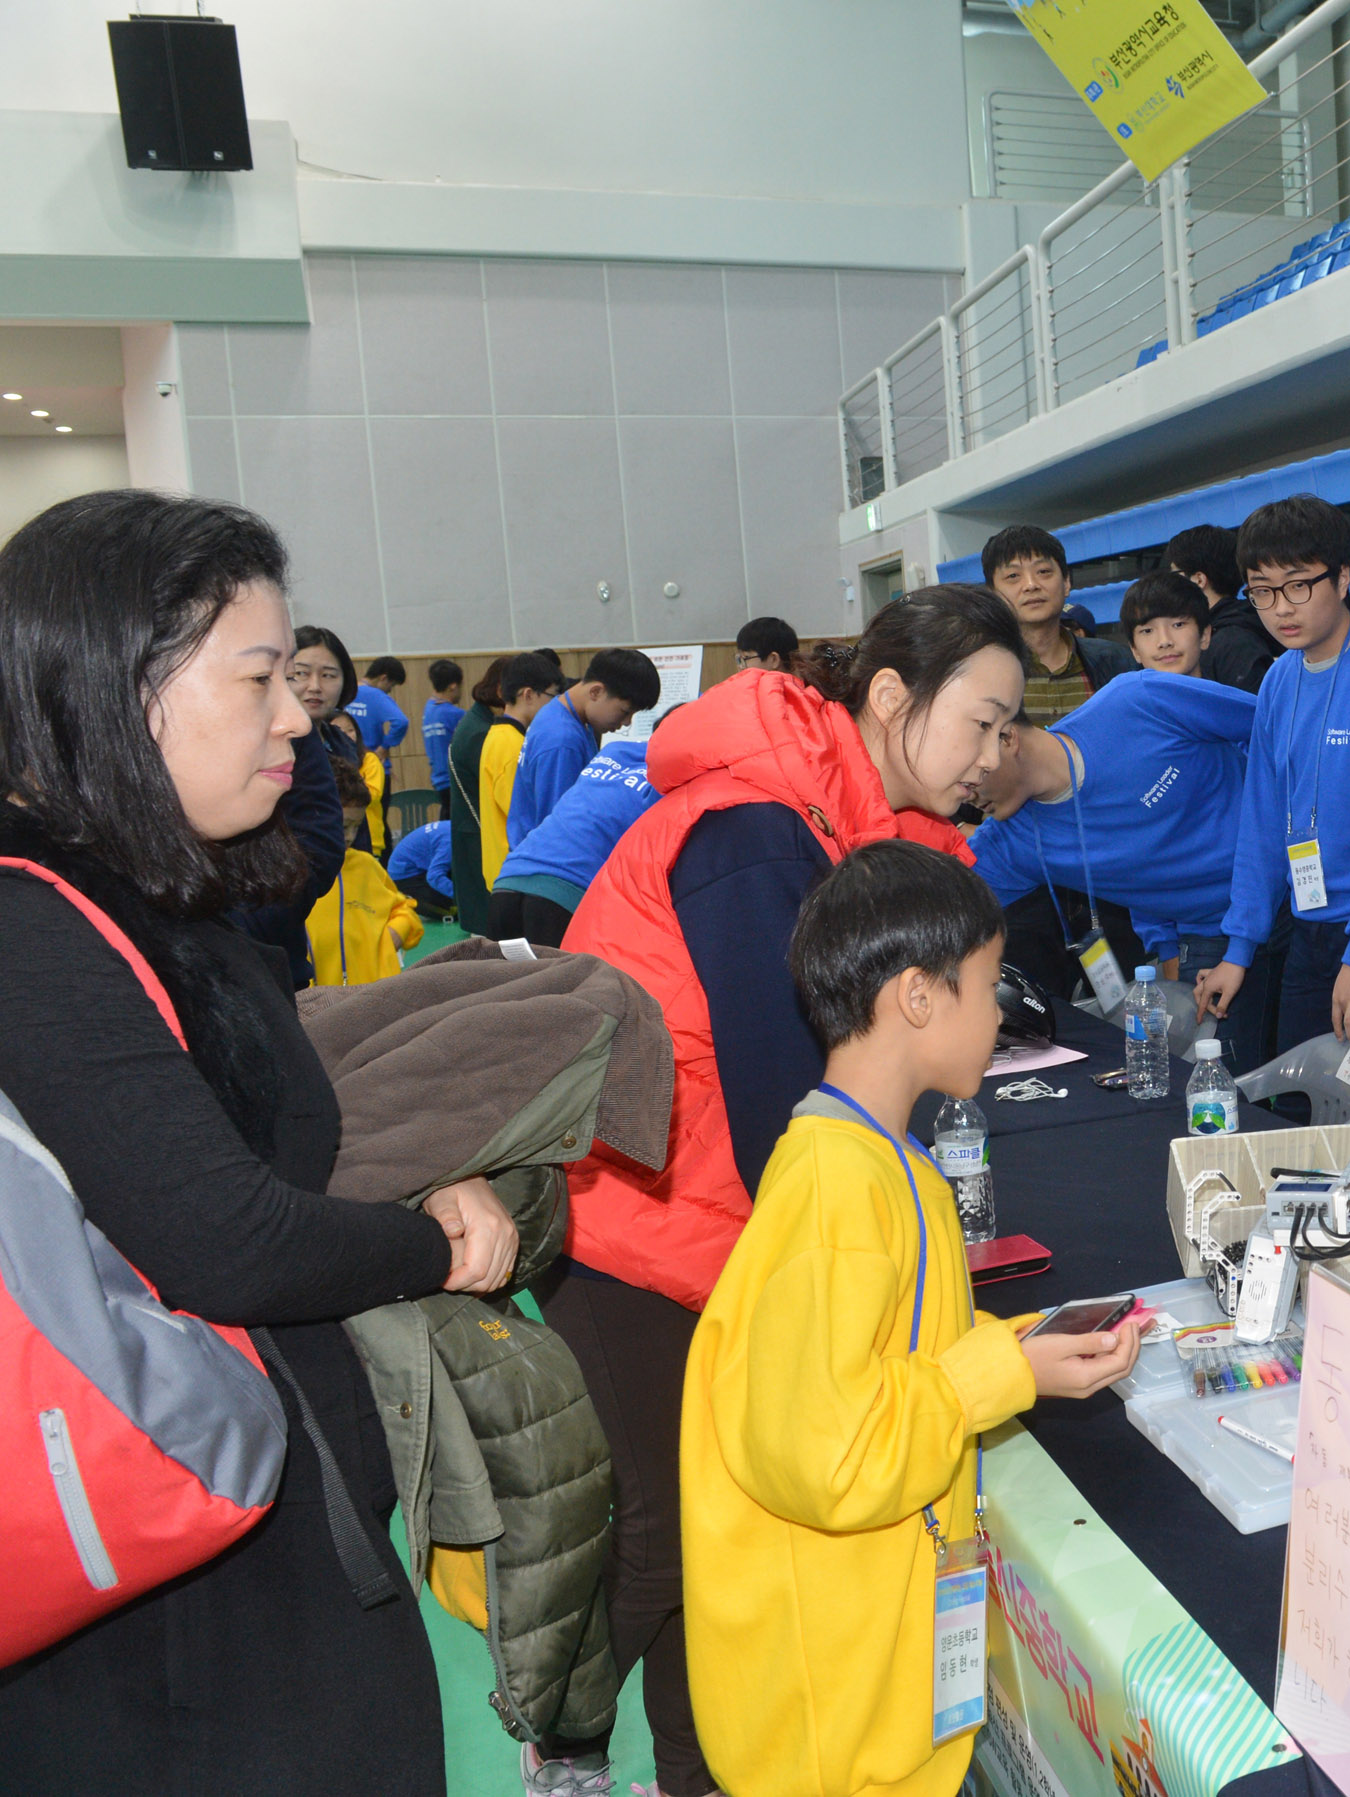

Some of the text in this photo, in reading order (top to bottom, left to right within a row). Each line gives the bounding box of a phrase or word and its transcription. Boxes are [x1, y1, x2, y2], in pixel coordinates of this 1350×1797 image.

[1109, 2, 1179, 70] 부산광역시교육청
[1177, 50, 1214, 82] 부산광역시
[1145, 768, 1180, 808] Festival
[1023, 996, 1046, 1014] alton
[947, 1147, 981, 1160] 스파클
[1297, 1609, 1340, 1670] 저희가
